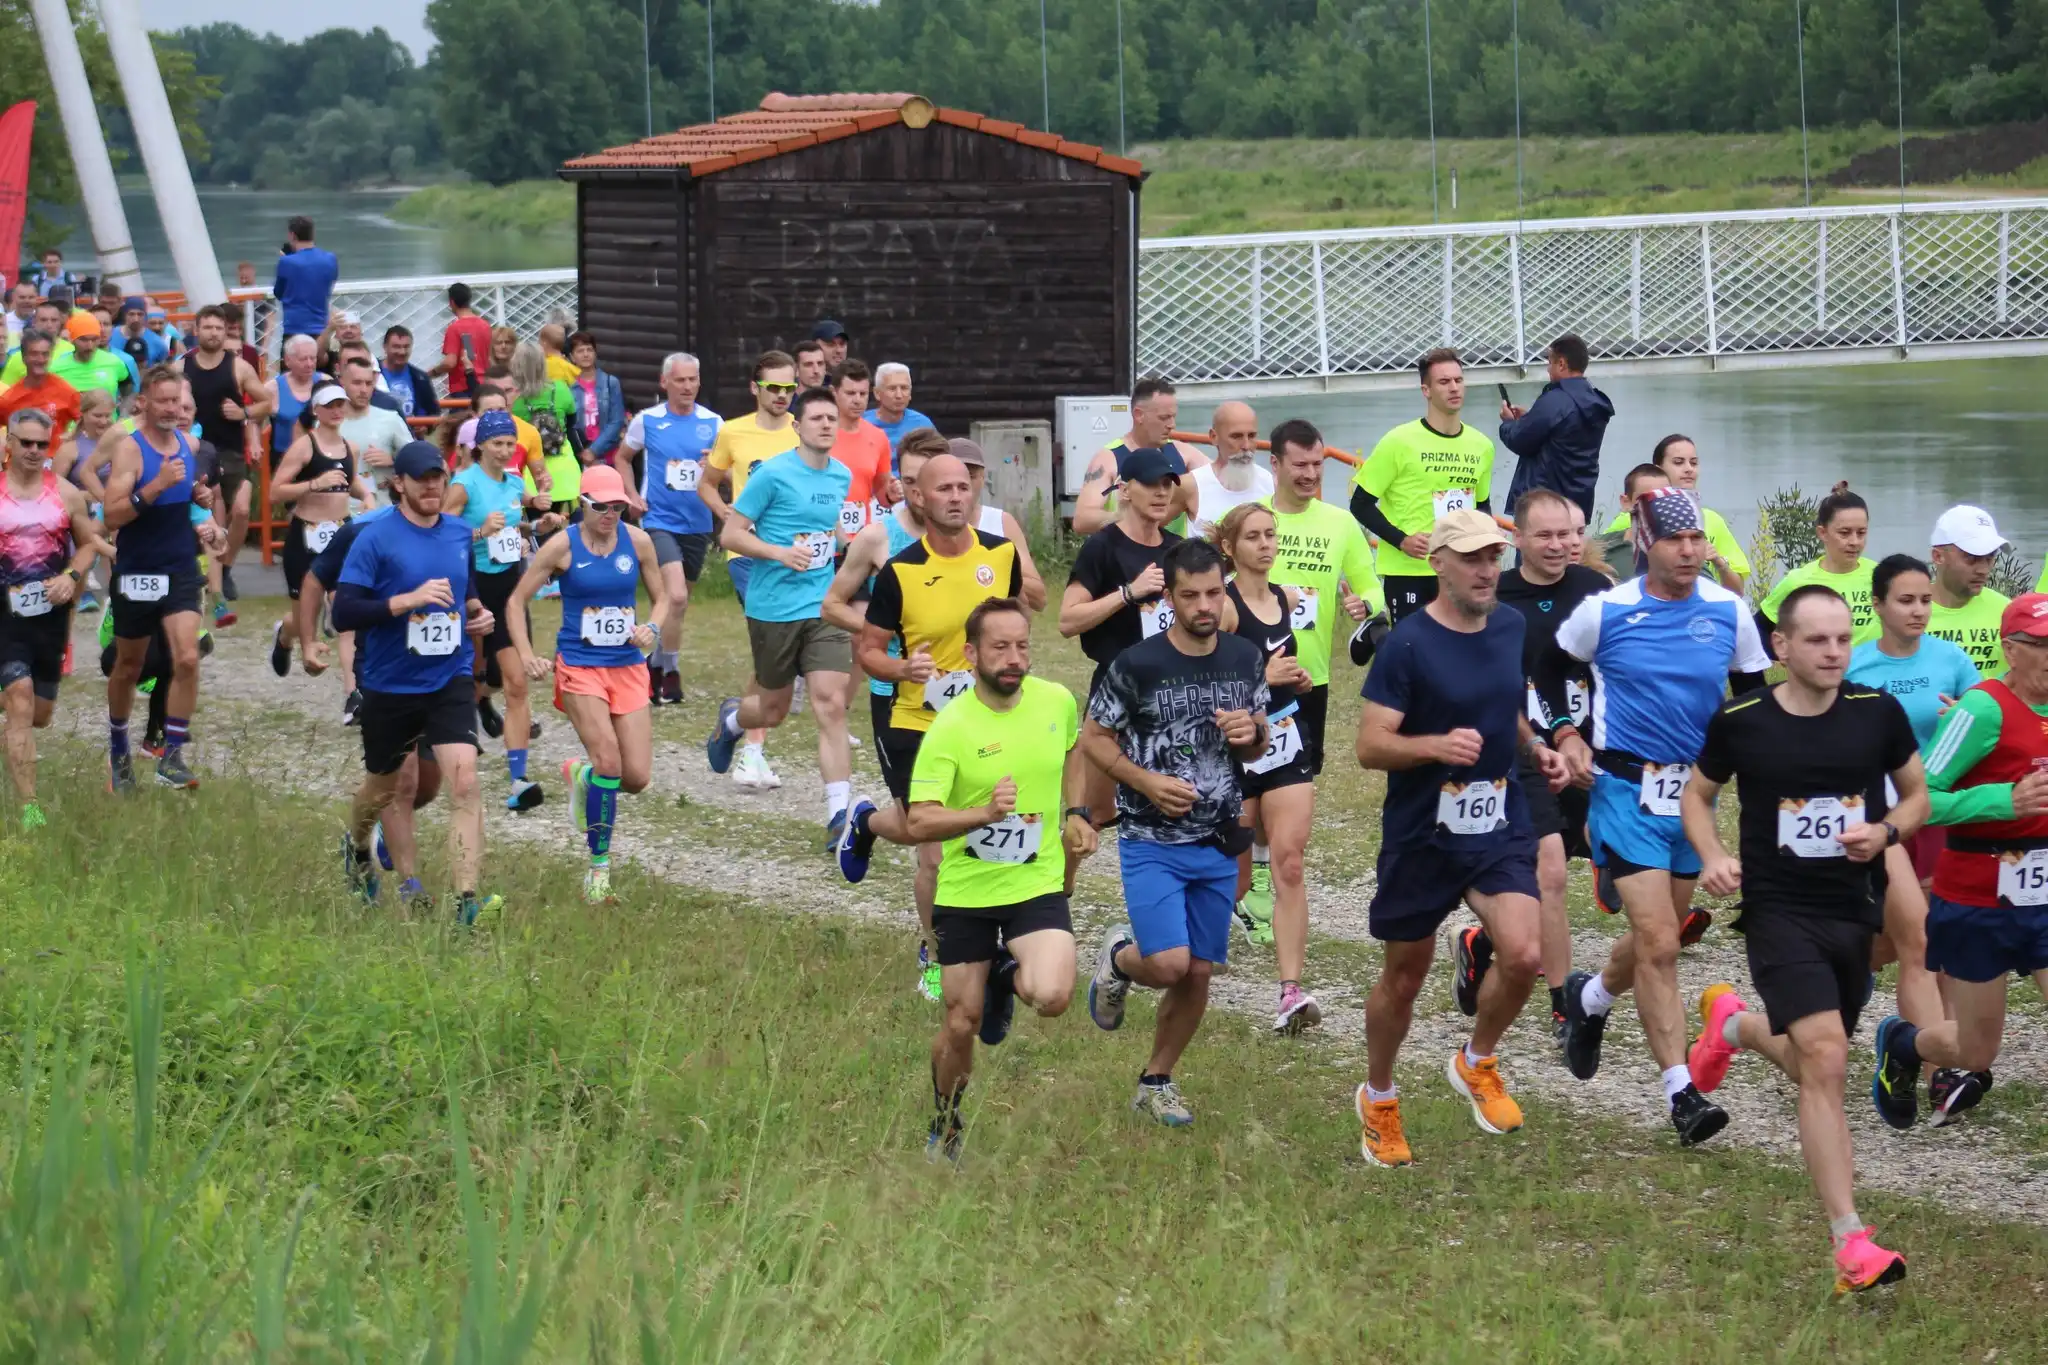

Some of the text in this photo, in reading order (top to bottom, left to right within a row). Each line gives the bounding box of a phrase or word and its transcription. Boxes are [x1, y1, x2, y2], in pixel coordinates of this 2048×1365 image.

[779, 219, 1012, 270] DRAVA
[1421, 452, 1481, 464] PRIZMA V&V
[680, 469, 695, 482] 51
[1425, 465, 1475, 476] running
[1447, 499, 1463, 512] 68
[842, 511, 860, 525] 98
[497, 536, 521, 552] 196
[808, 541, 830, 558] 37
[1306, 536, 1331, 549] V&V
[130, 577, 160, 591] 158
[20, 589, 49, 608] 275
[1406, 592, 1417, 604] 18
[1294, 599, 1306, 615] 5
[594, 618, 625, 634] 163
[1158, 610, 1176, 630] 82
[420, 625, 452, 643] 121
[1970, 628, 2000, 642] V&V
[1974, 659, 1999, 671] am
[943, 684, 968, 700] 44
[1570, 694, 1582, 713] 5
[1655, 778, 1689, 800] 12
[1456, 796, 1496, 819] 160
[1796, 815, 1846, 839] 261
[980, 826, 1025, 849] 271
